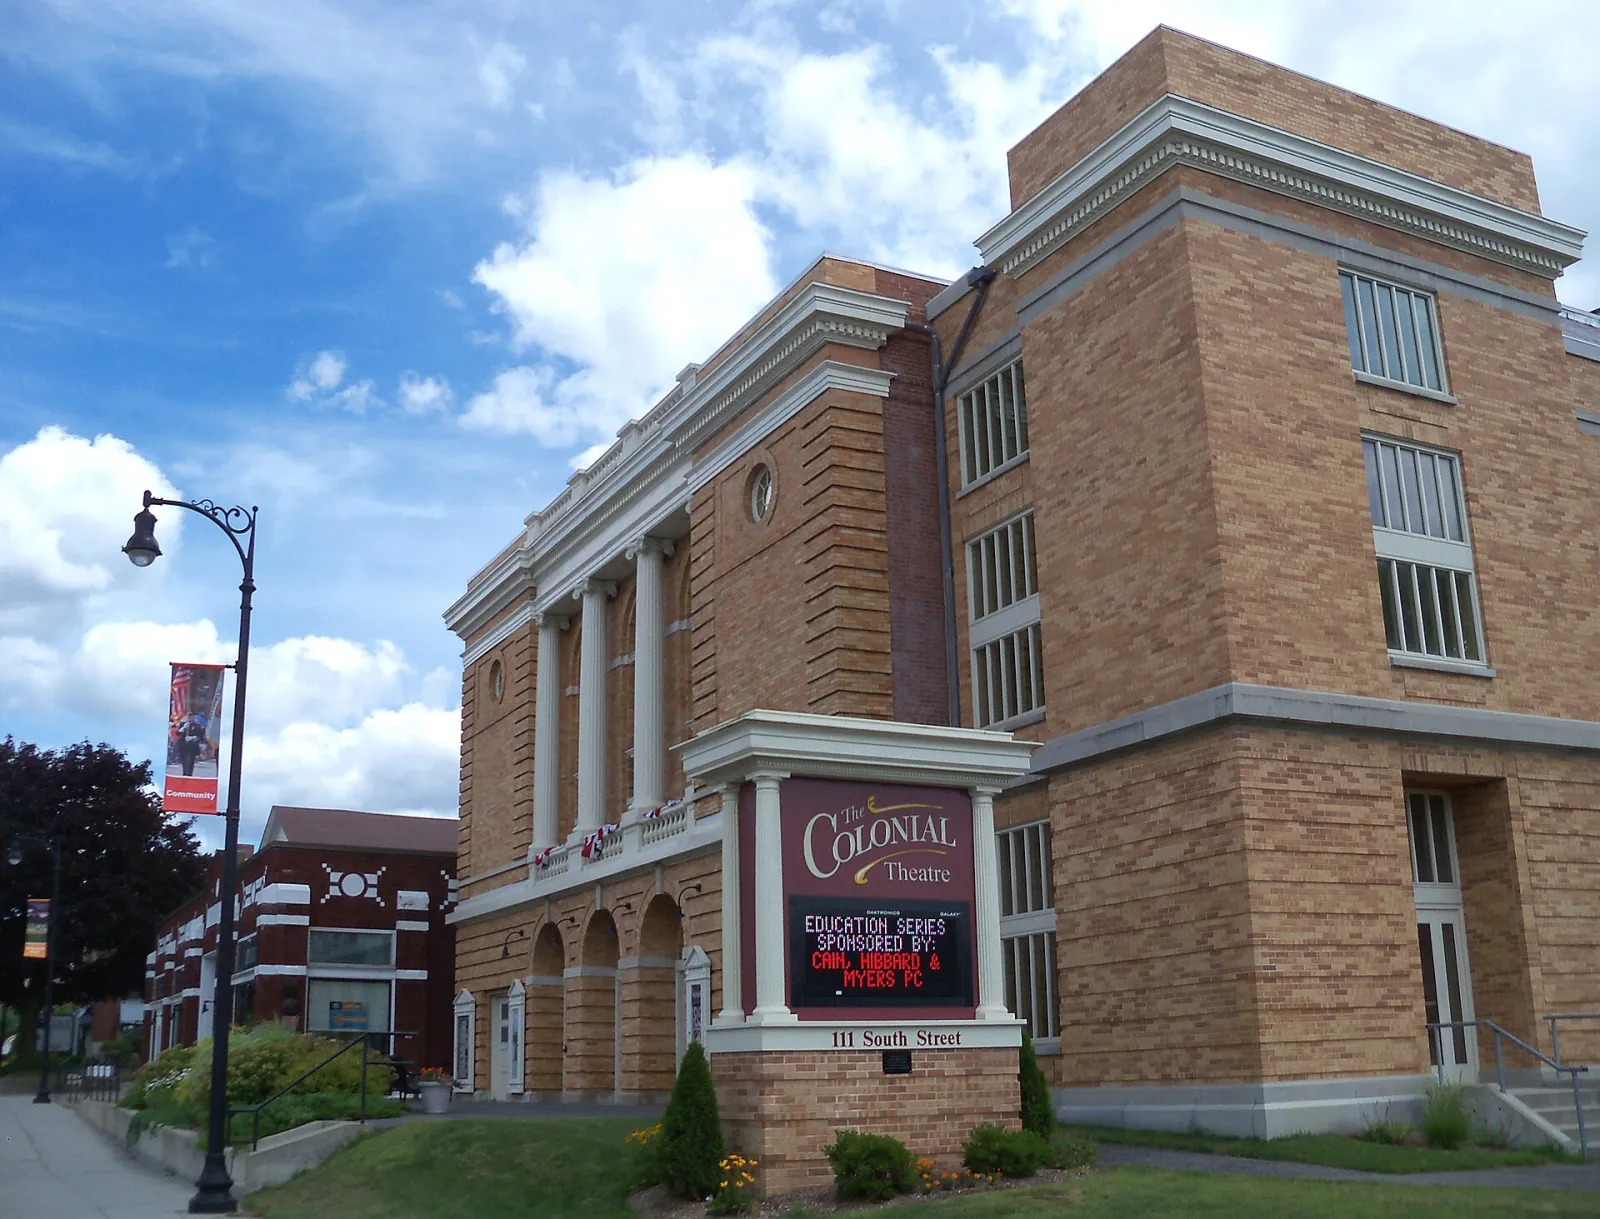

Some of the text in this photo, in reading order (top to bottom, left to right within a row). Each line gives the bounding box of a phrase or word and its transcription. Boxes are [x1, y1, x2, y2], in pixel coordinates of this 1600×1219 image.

[166, 789, 216, 800] Community
[841, 805, 865, 825] The
[884, 861, 950, 882] Theatre
[805, 915, 946, 936] EDUCATION SERIES
[817, 934, 937, 952] SPONSORED BY:
[812, 952, 941, 971] CAIN, HIBBARD &
[844, 972, 923, 988] MYERS PC
[832, 1029, 962, 1048] 111 South Street
